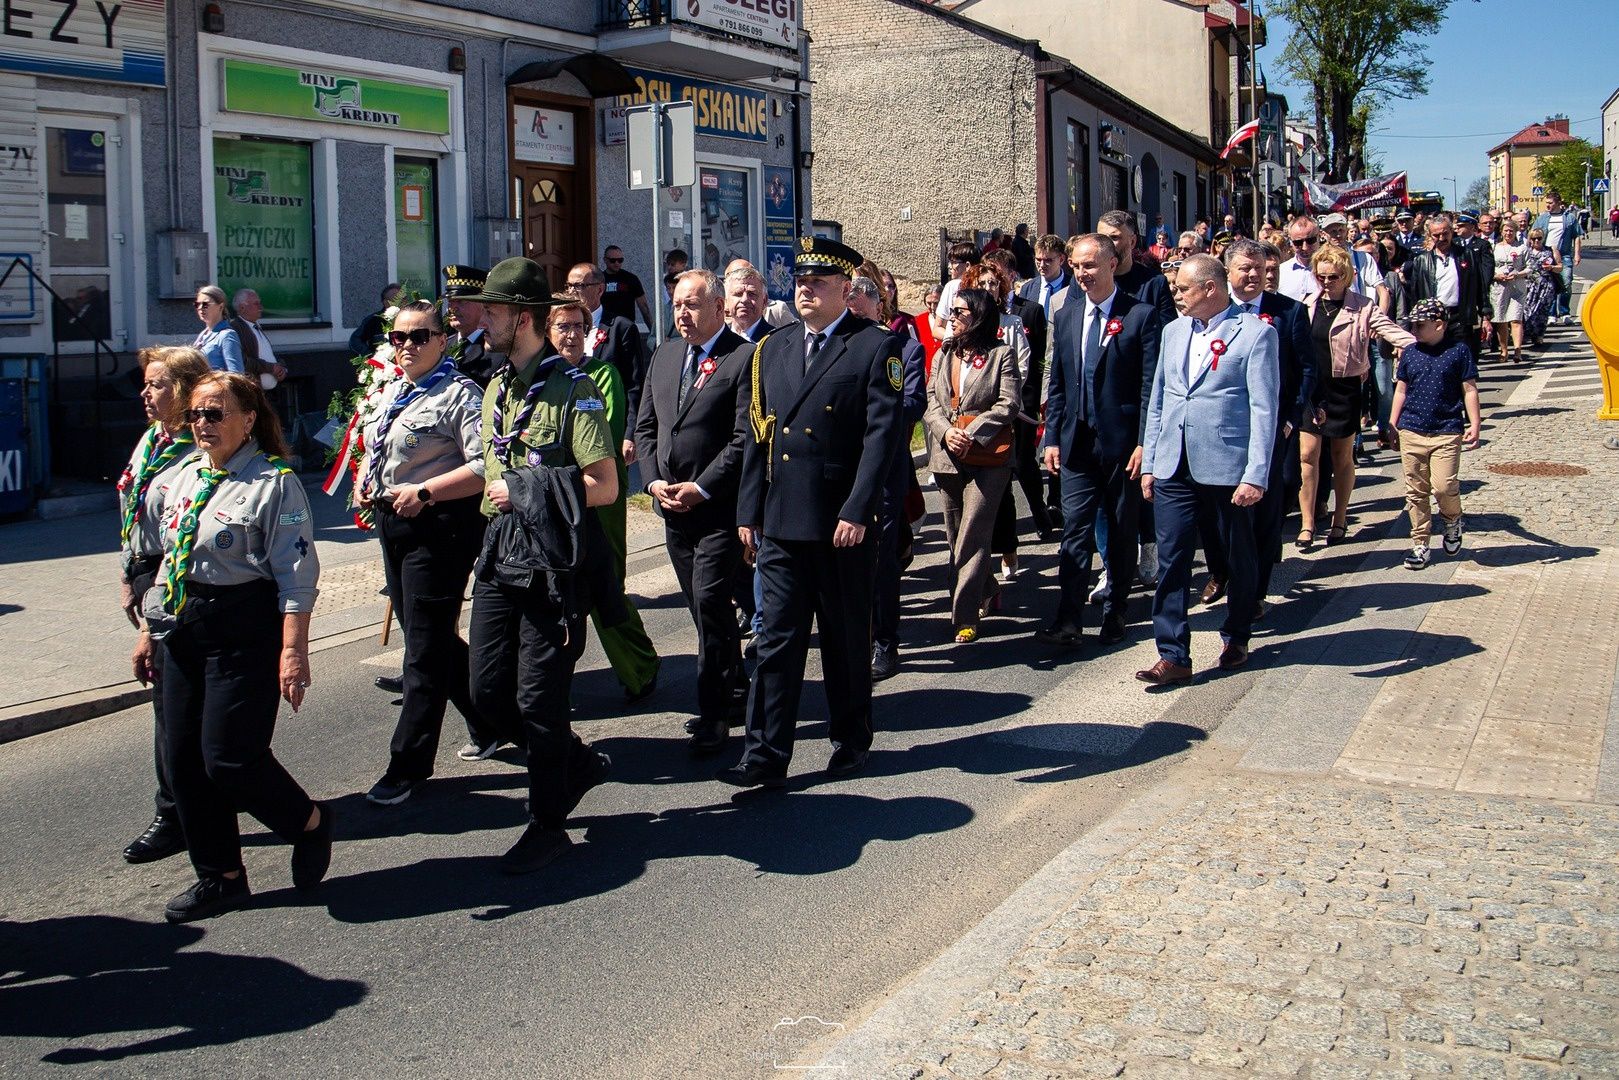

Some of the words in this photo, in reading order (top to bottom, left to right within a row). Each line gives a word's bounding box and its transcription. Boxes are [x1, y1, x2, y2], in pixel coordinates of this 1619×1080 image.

[300, 72, 335, 87] MINI
[341, 108, 400, 125] KREDYT
[215, 166, 246, 178] MINI
[251, 195, 304, 207] KREDYT
[224, 221, 296, 249] POŻYCZKI
[217, 249, 309, 279] GOTÓWKOWE
